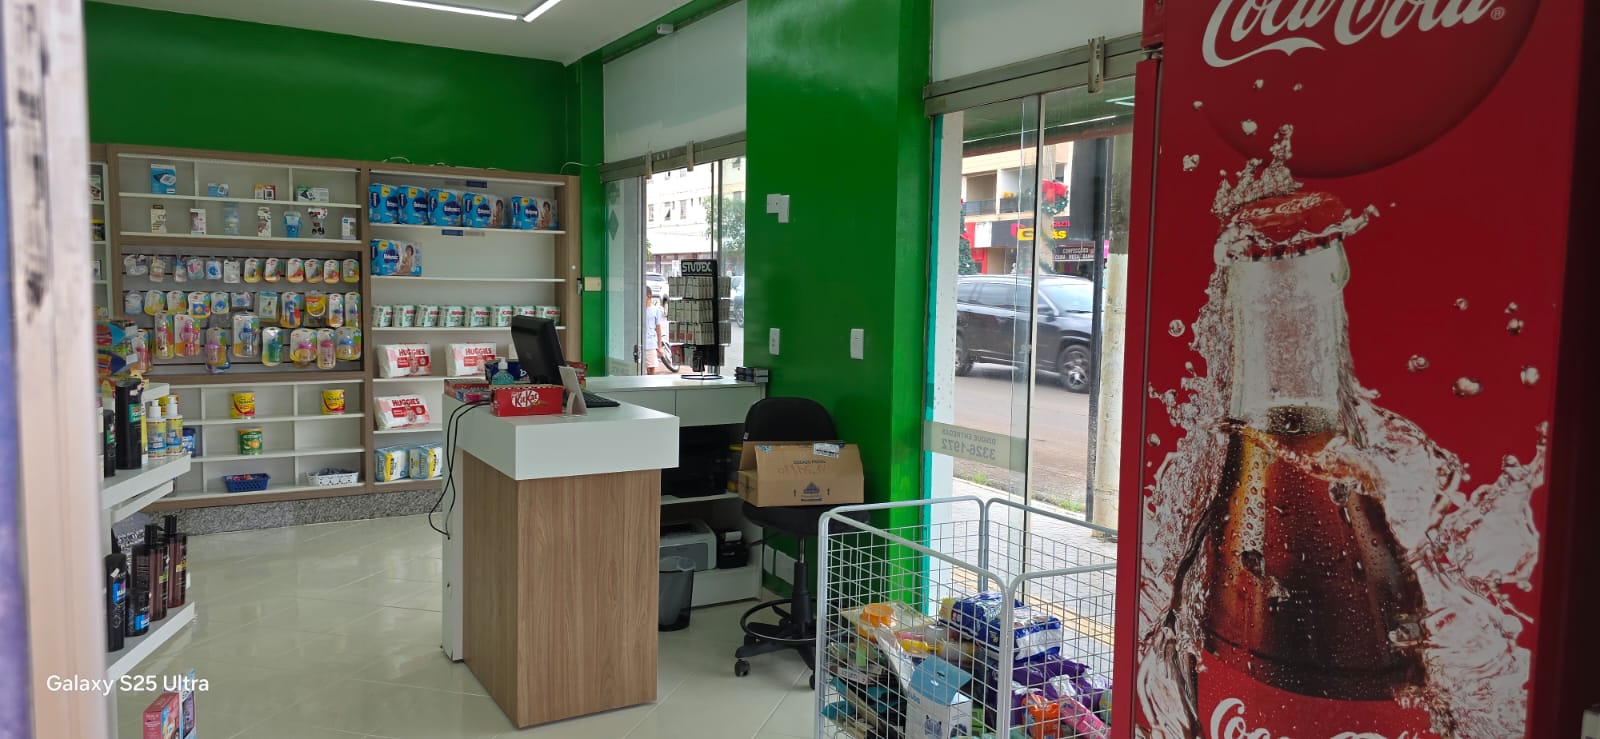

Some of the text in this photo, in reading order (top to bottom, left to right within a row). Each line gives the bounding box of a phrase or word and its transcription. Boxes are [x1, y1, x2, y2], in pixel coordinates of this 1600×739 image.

[681, 261, 711, 273] STUDEX
[465, 347, 492, 355] HUGGIES
[391, 398, 420, 407] HUGGIES
